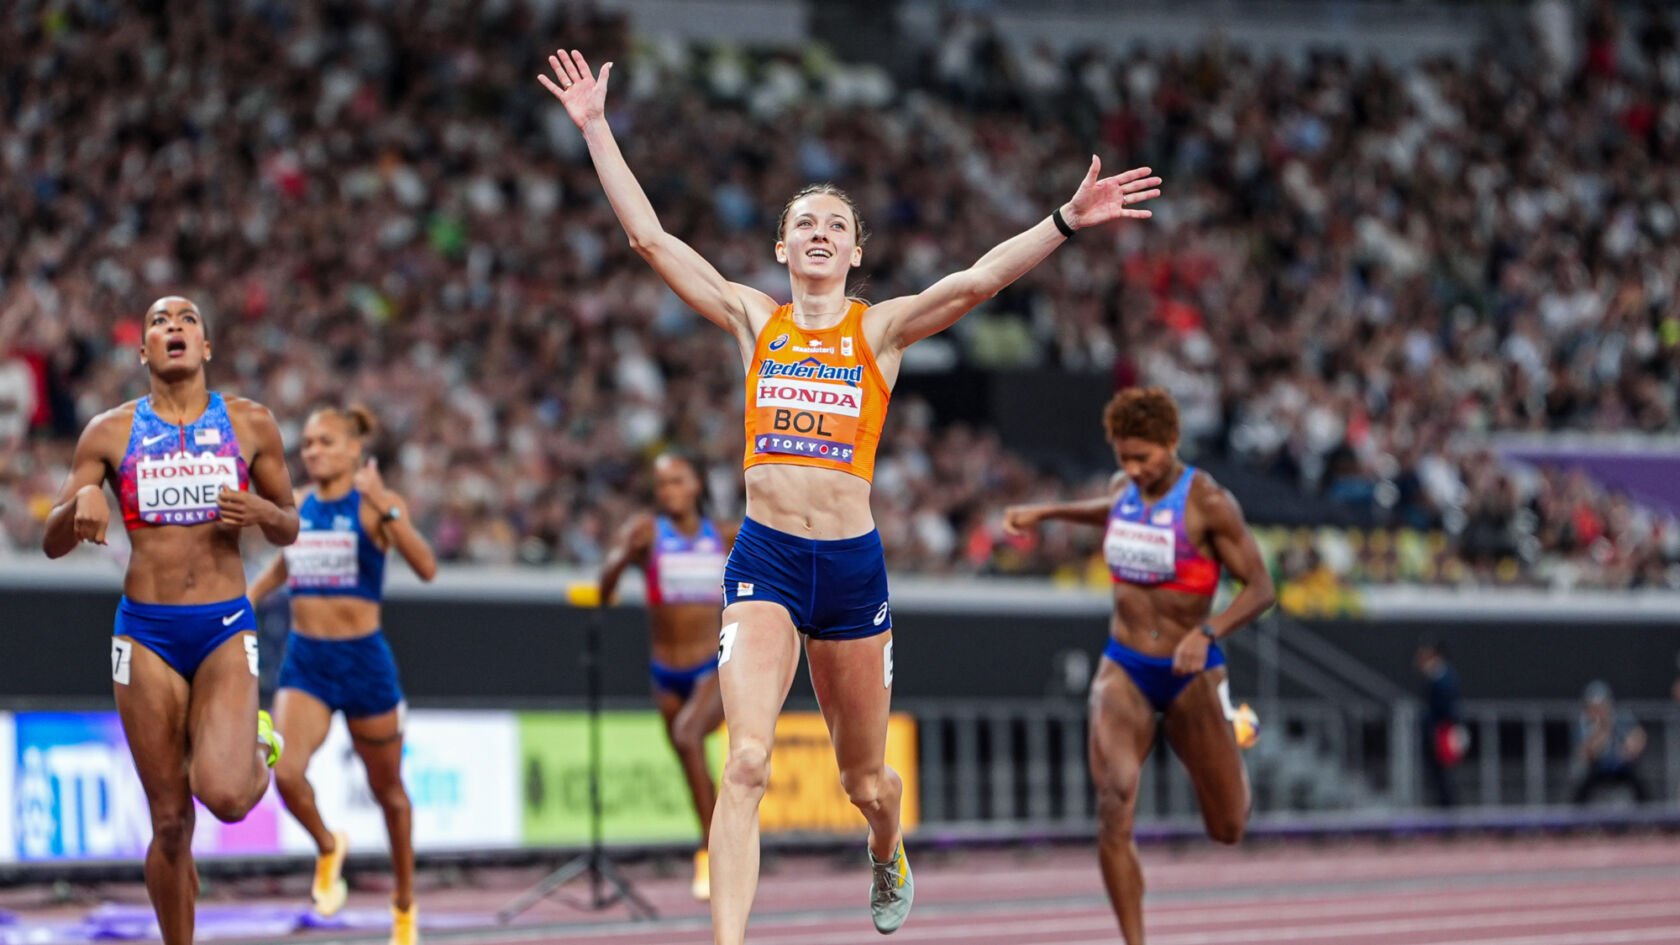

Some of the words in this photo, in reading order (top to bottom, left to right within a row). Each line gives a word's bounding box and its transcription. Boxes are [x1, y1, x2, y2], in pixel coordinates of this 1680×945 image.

[758, 386, 858, 409] HONDA
[773, 409, 832, 437] BOL
[141, 464, 232, 479] HONDA
[115, 646, 123, 675] 7
